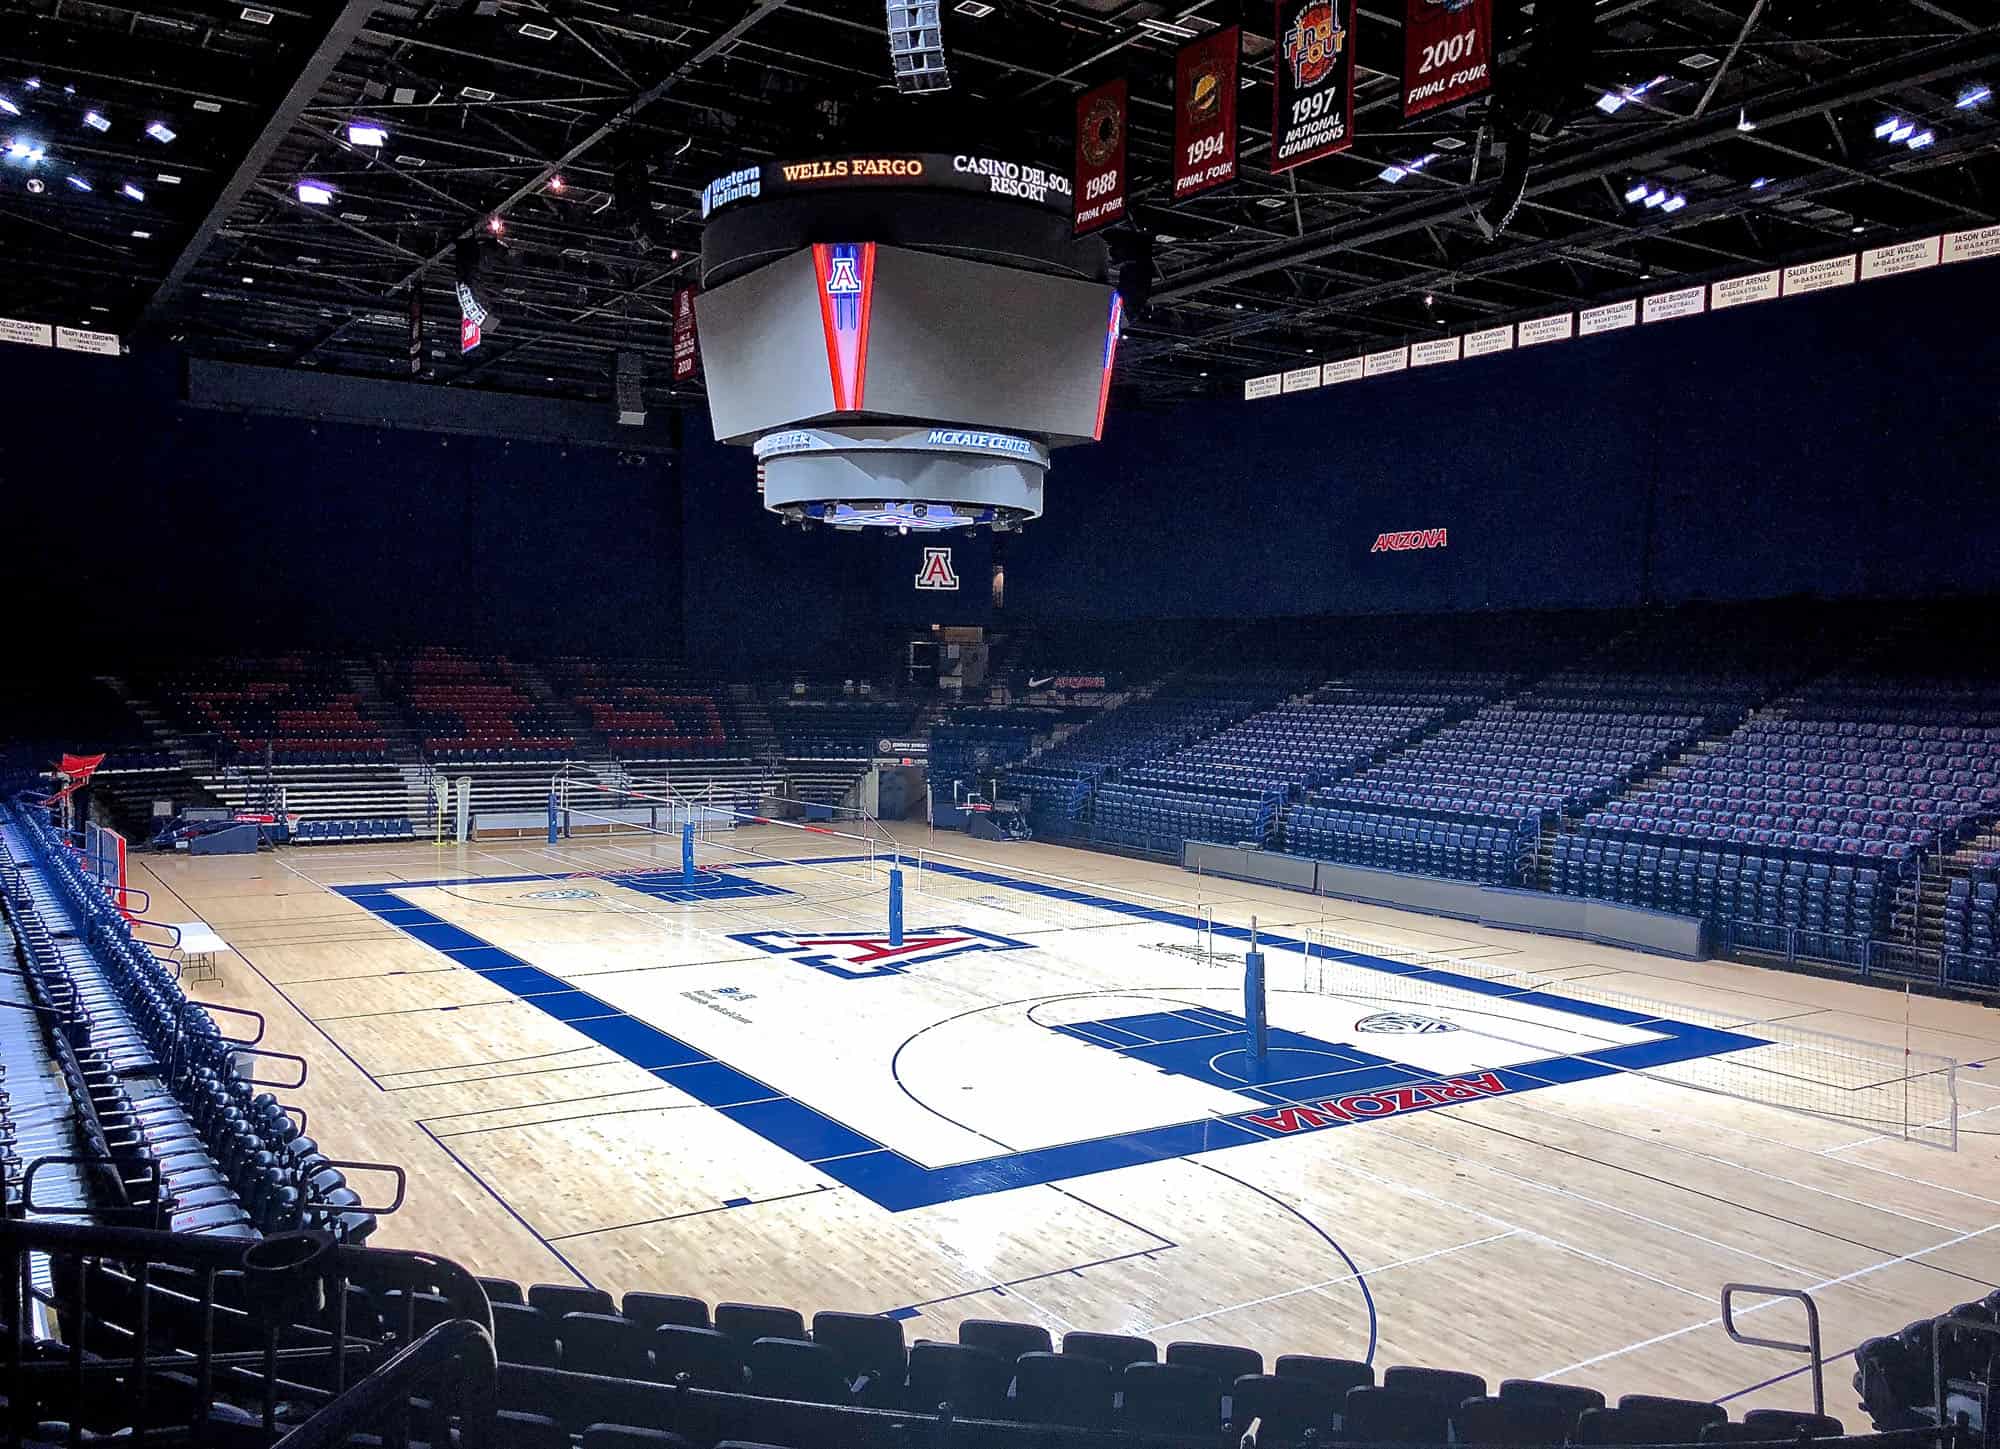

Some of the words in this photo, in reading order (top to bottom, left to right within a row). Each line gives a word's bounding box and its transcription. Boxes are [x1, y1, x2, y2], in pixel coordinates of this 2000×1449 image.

[1419, 29, 1475, 74] 2001
[1408, 78, 1446, 104] FINAL
[1448, 64, 1488, 88] FOUR
[1292, 87, 1336, 125] 1997
[1278, 125, 1344, 159] CHAMPIONS
[1285, 112, 1340, 143] NATIONAL
[1187, 131, 1225, 166] 1994
[712, 166, 760, 194] Western
[783, 160, 848, 182] WELLS
[852, 159, 923, 176] FARGO
[953, 155, 1019, 179] CASINO
[1021, 165, 1048, 188] DEL
[1049, 173, 1072, 196] SOL
[1086, 170, 1117, 200] 1988
[1177, 173, 1204, 191] FINAL
[1206, 162, 1233, 180] FOUR
[712, 180, 760, 209] Refining
[990, 176, 1047, 202] RESORT
[1077, 207, 1099, 224] FINAL
[1101, 196, 1123, 215] FOUR
[1877, 248, 1895, 259] LUKE
[1898, 242, 1925, 255] WALTON
[1955, 231, 1978, 243] JASON
[826, 258, 861, 292] A
[989, 436, 1032, 454] CENTER
[1370, 528, 1447, 552] ARIZONA
[915, 547, 959, 590] A
[1241, 1072, 1512, 1133] ARIZONA
